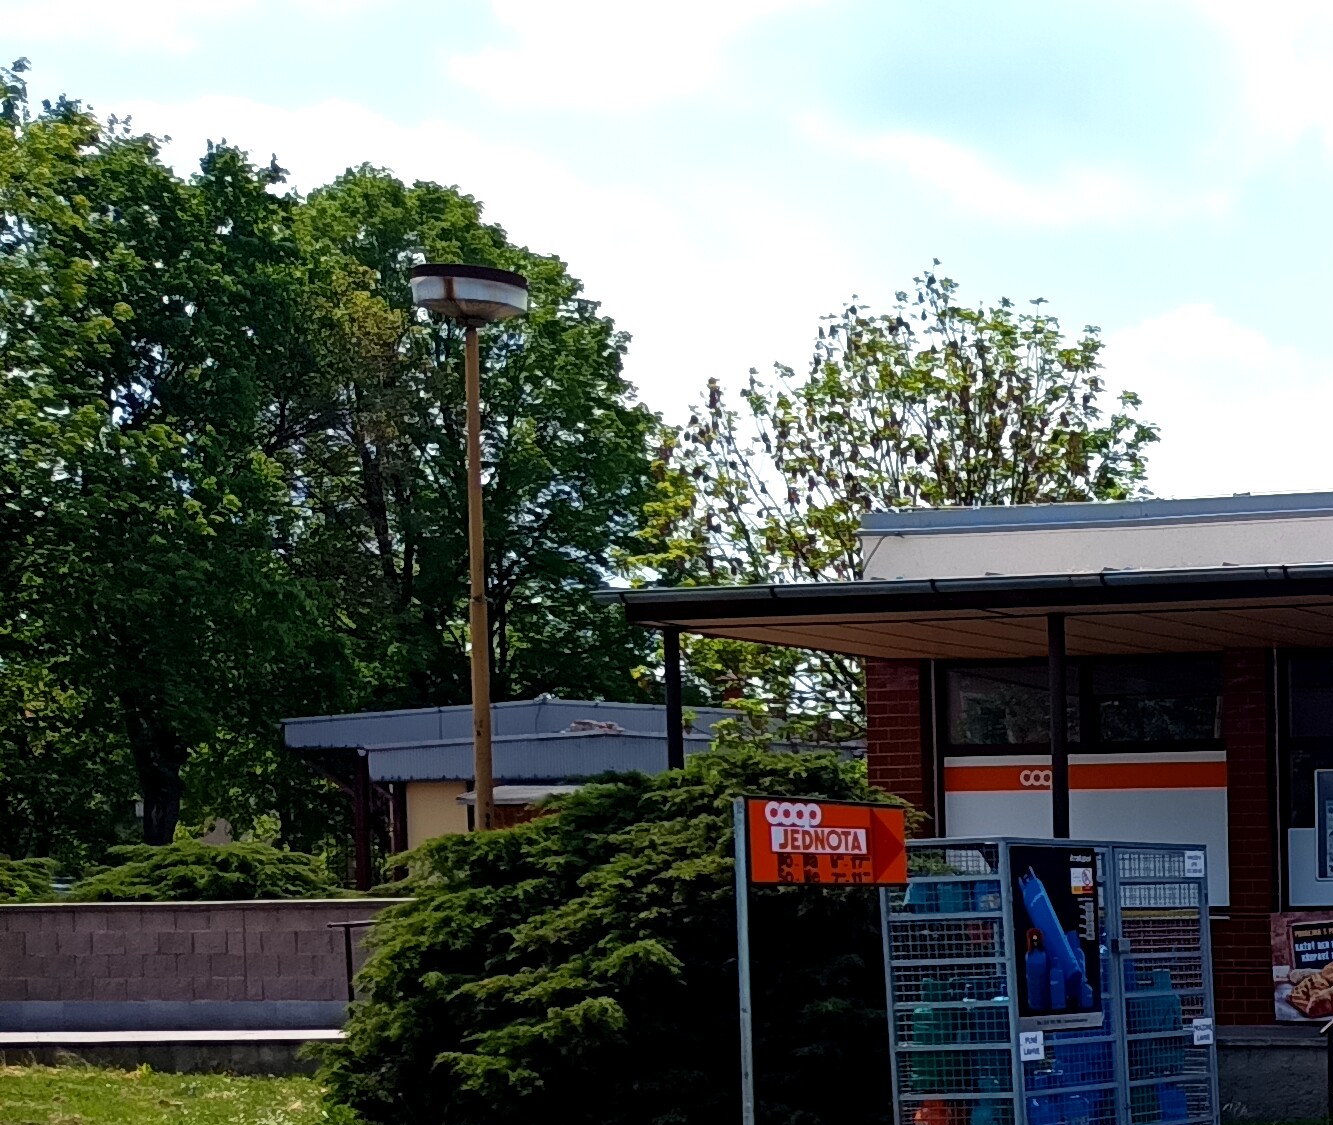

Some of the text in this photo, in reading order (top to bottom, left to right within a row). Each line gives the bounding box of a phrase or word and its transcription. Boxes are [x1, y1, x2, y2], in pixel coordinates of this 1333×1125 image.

[1019, 769, 1053, 790] coo
[764, 800, 822, 829] coop
[778, 828, 863, 852] JEDNOTA
